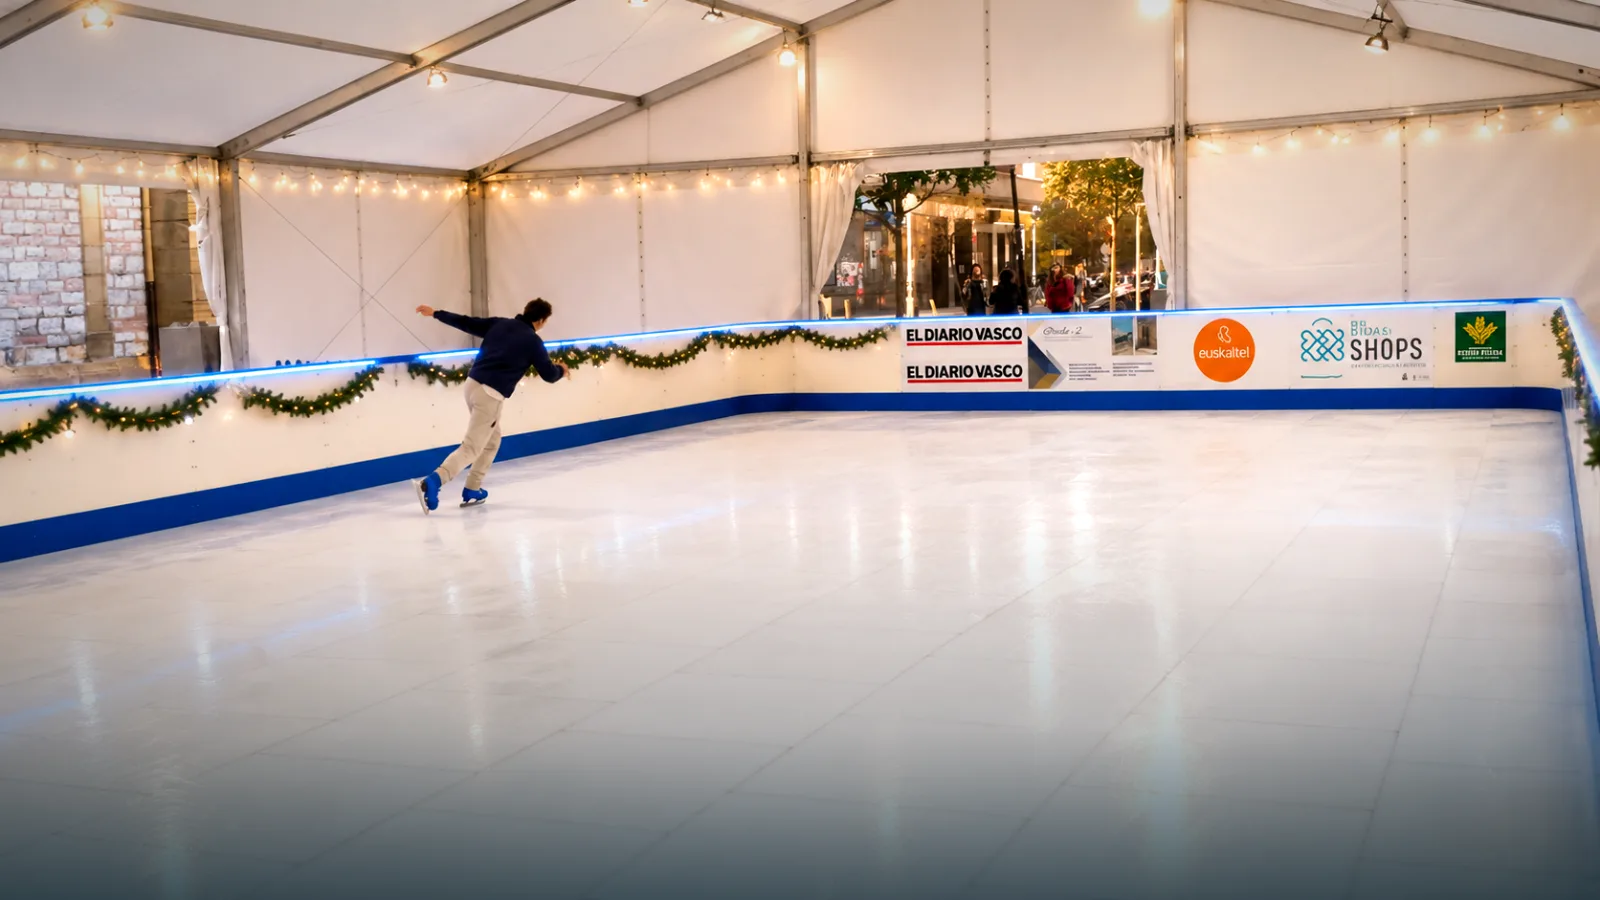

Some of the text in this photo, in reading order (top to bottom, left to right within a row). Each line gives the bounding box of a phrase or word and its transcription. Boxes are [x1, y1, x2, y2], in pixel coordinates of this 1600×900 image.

[906, 327, 1022, 341] EL DIARIO VASCO
[1199, 346, 1250, 358] euskaltel
[1350, 338, 1422, 361] SHOPS
[907, 364, 1023, 378] EL DIARIO VASCO
